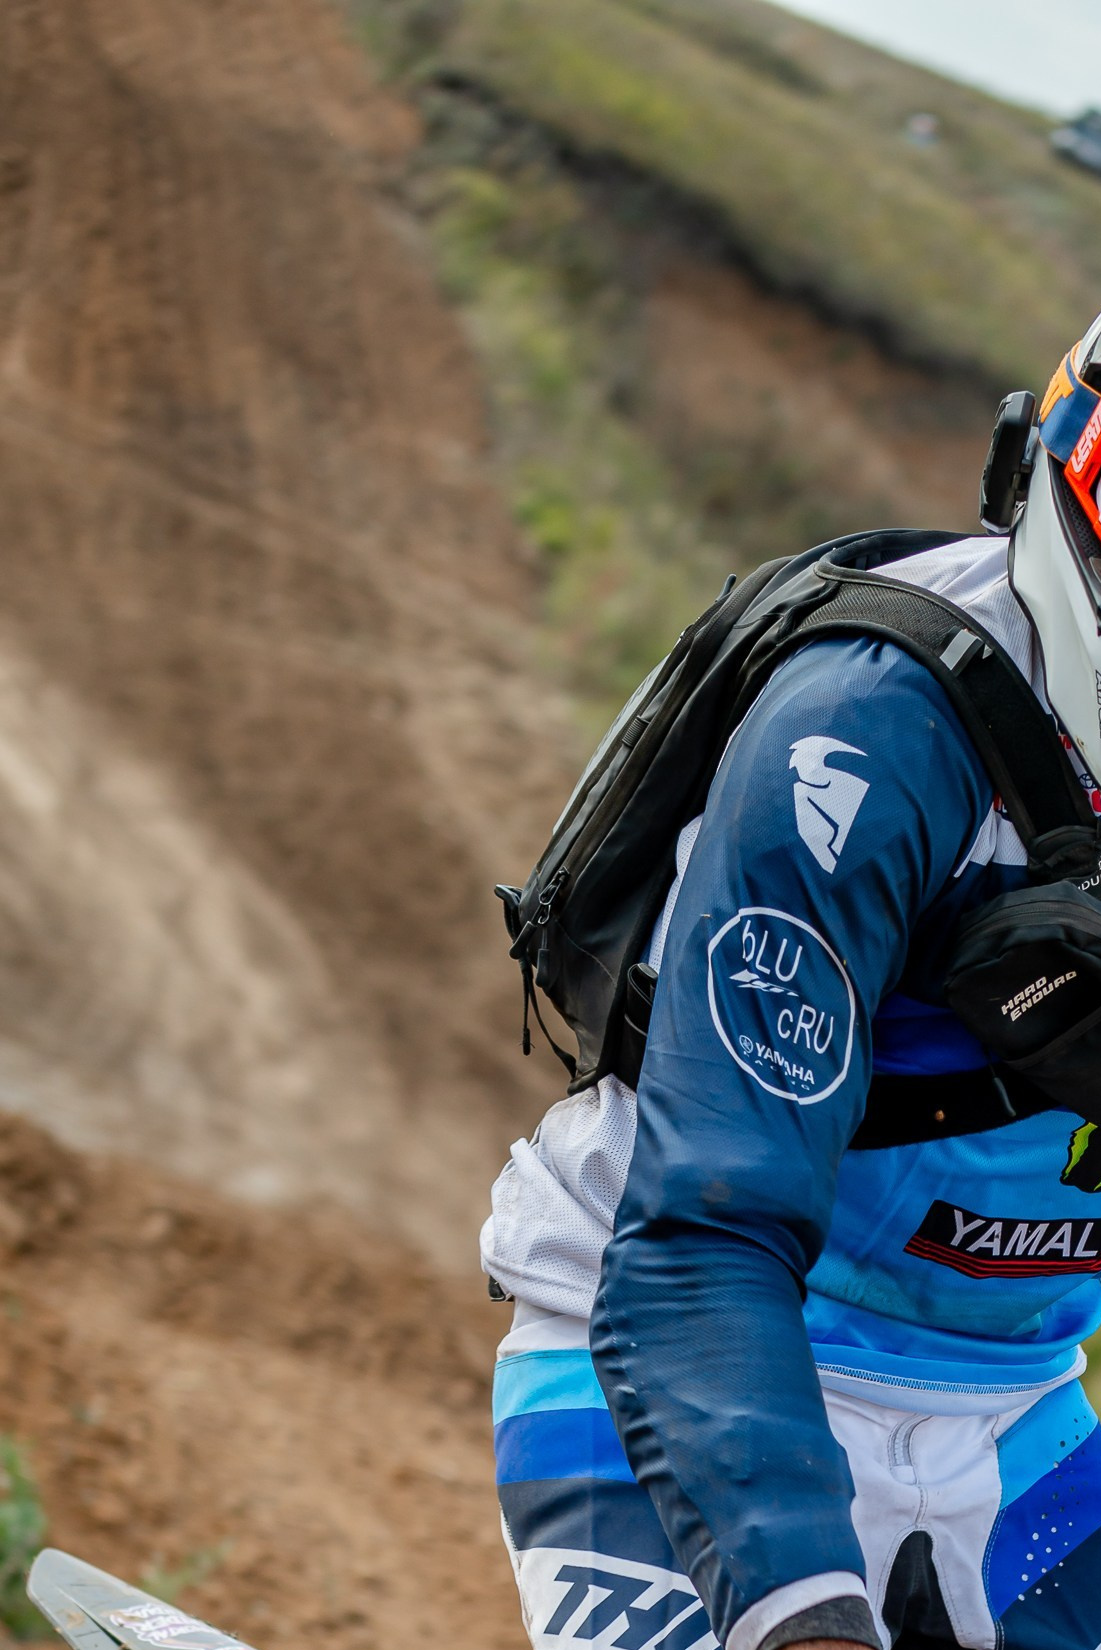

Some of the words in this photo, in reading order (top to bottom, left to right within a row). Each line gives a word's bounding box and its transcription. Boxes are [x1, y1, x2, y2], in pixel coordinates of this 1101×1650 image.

[1001, 975, 1047, 1016] HARD
[1010, 970, 1077, 1022] ENDURO
[755, 1042, 815, 1085] YAMAHA
